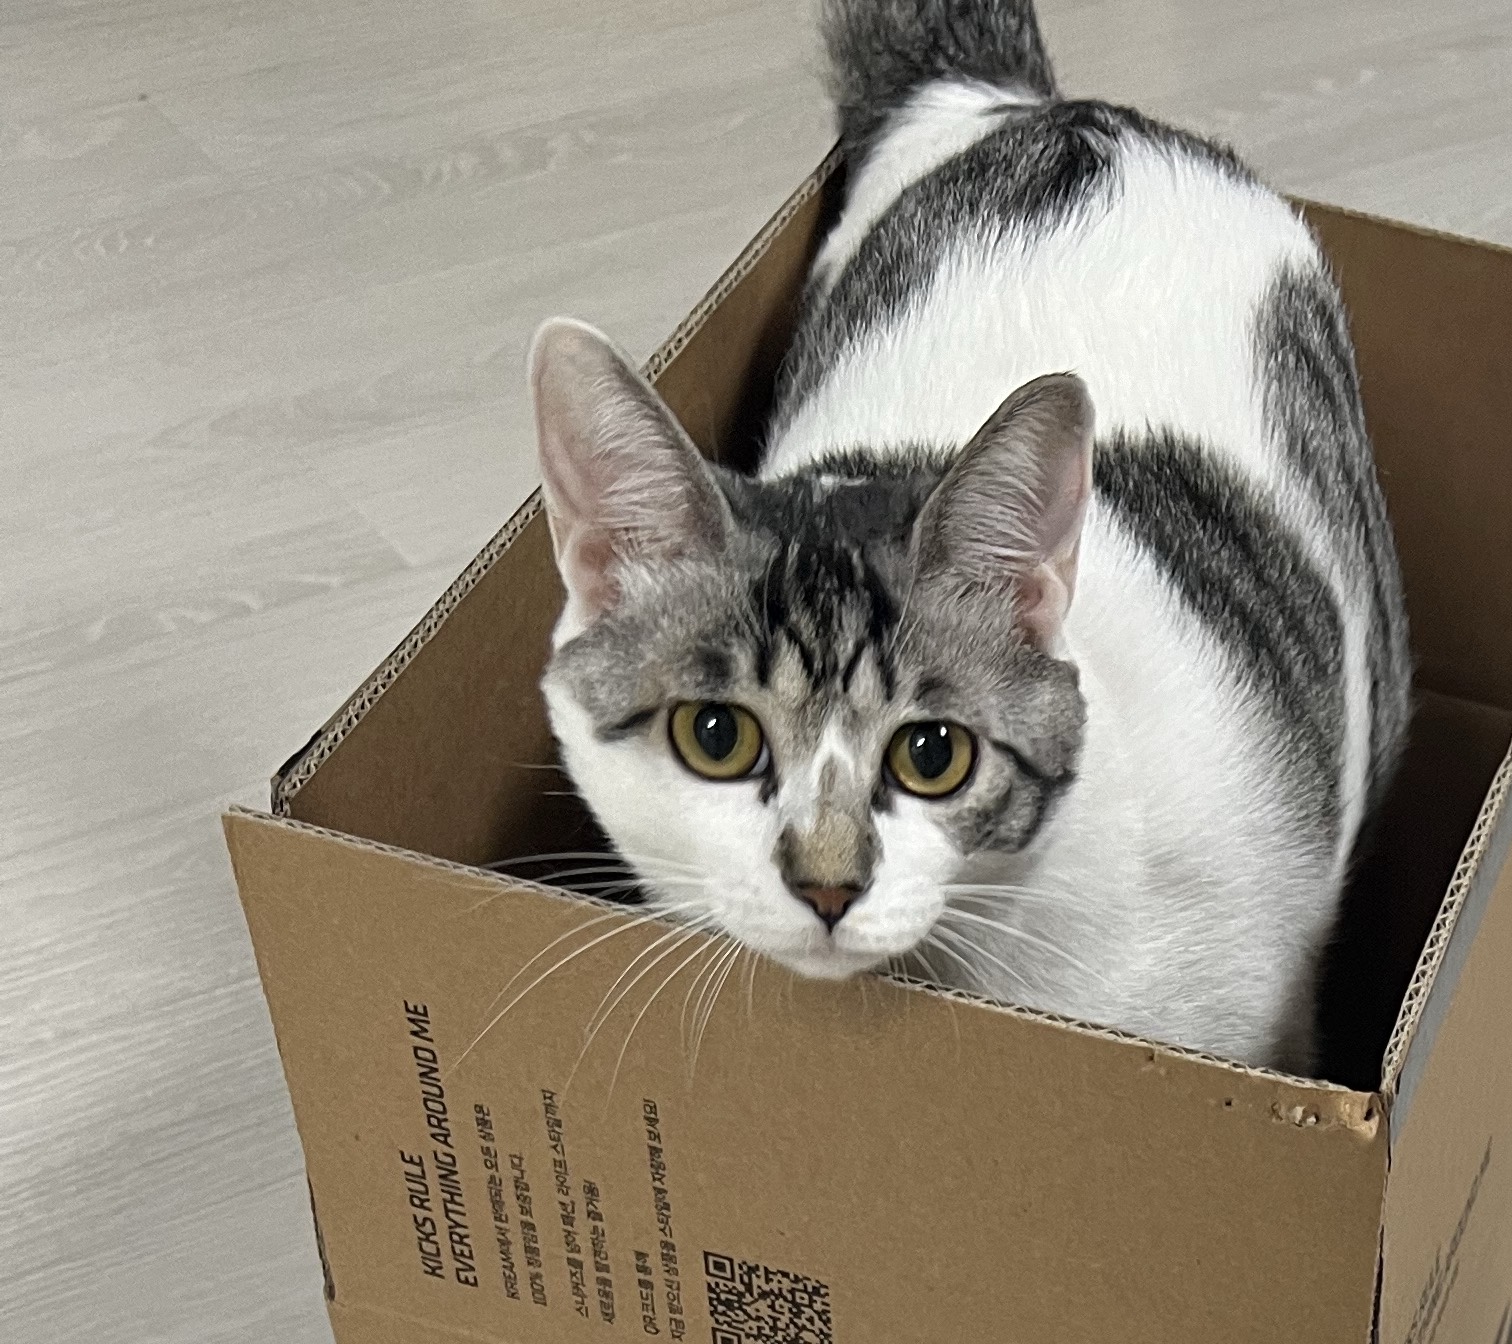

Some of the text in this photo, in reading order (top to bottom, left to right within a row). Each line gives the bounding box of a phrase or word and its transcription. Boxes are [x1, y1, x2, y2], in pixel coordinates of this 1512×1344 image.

[474, 1103, 495, 1143] 상품은
[404, 999, 479, 1288] EVERYTHING AROUND ME
[553, 1157, 571, 1197] 라이프
[400, 1150, 445, 1279] KICKS RULE
[528, 1269, 547, 1306] 100%
[566, 1256, 590, 1319] 스니커즈를
[669, 1316, 687, 1343] 지금
